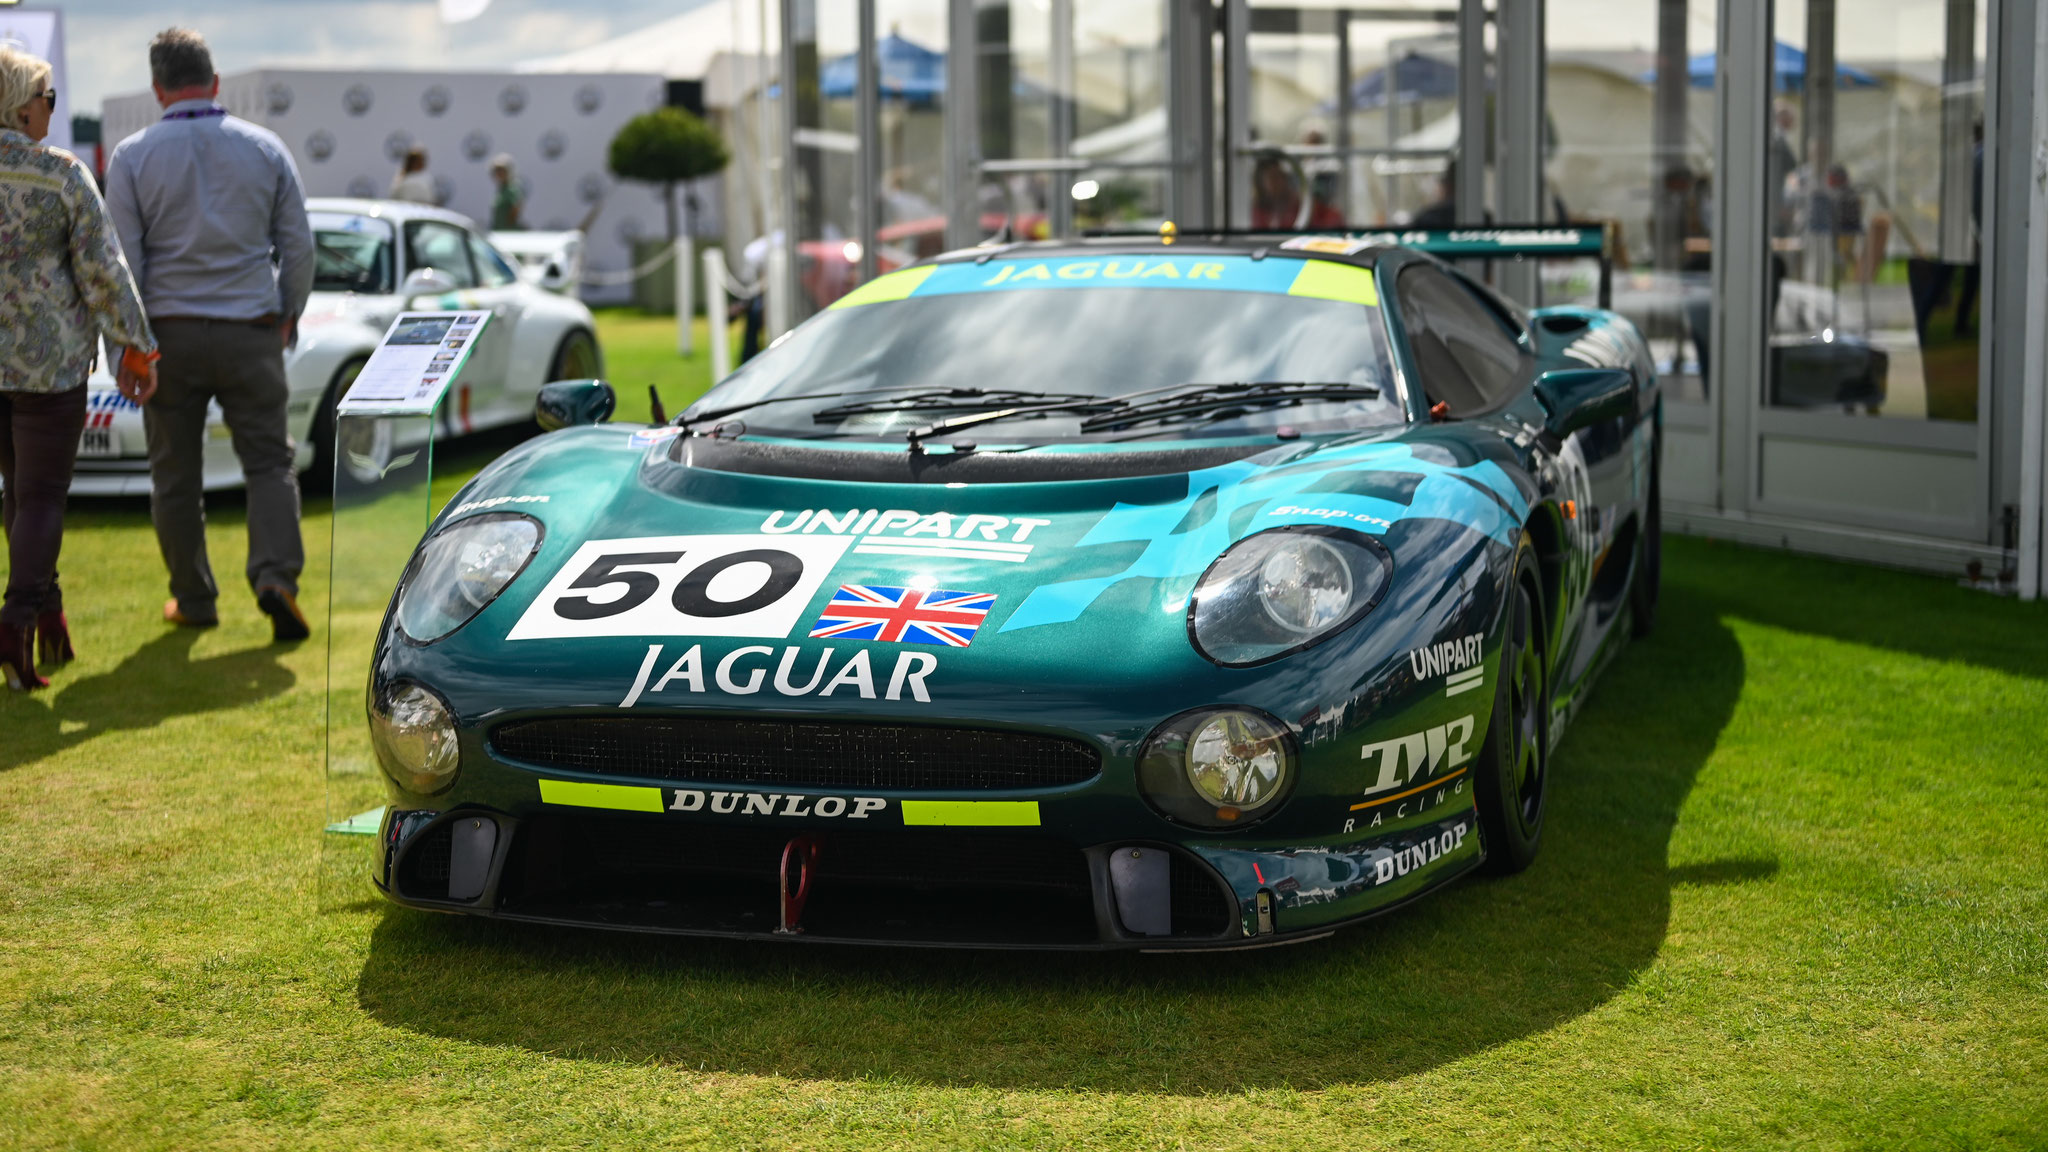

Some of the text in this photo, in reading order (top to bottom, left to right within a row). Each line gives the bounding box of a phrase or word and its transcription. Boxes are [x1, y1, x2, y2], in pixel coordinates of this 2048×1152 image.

[983, 262, 1225, 286] JAGUAR
[760, 509, 1051, 543] UNIPART
[553, 549, 804, 620] 50
[618, 644, 938, 708] JAGUAR
[1410, 632, 1484, 681] UNIPART
[1361, 714, 1474, 796] TWR
[669, 789, 887, 818] DUNLOP
[1343, 779, 1463, 834] RACING
[1375, 822, 1467, 886] DUNLOP
